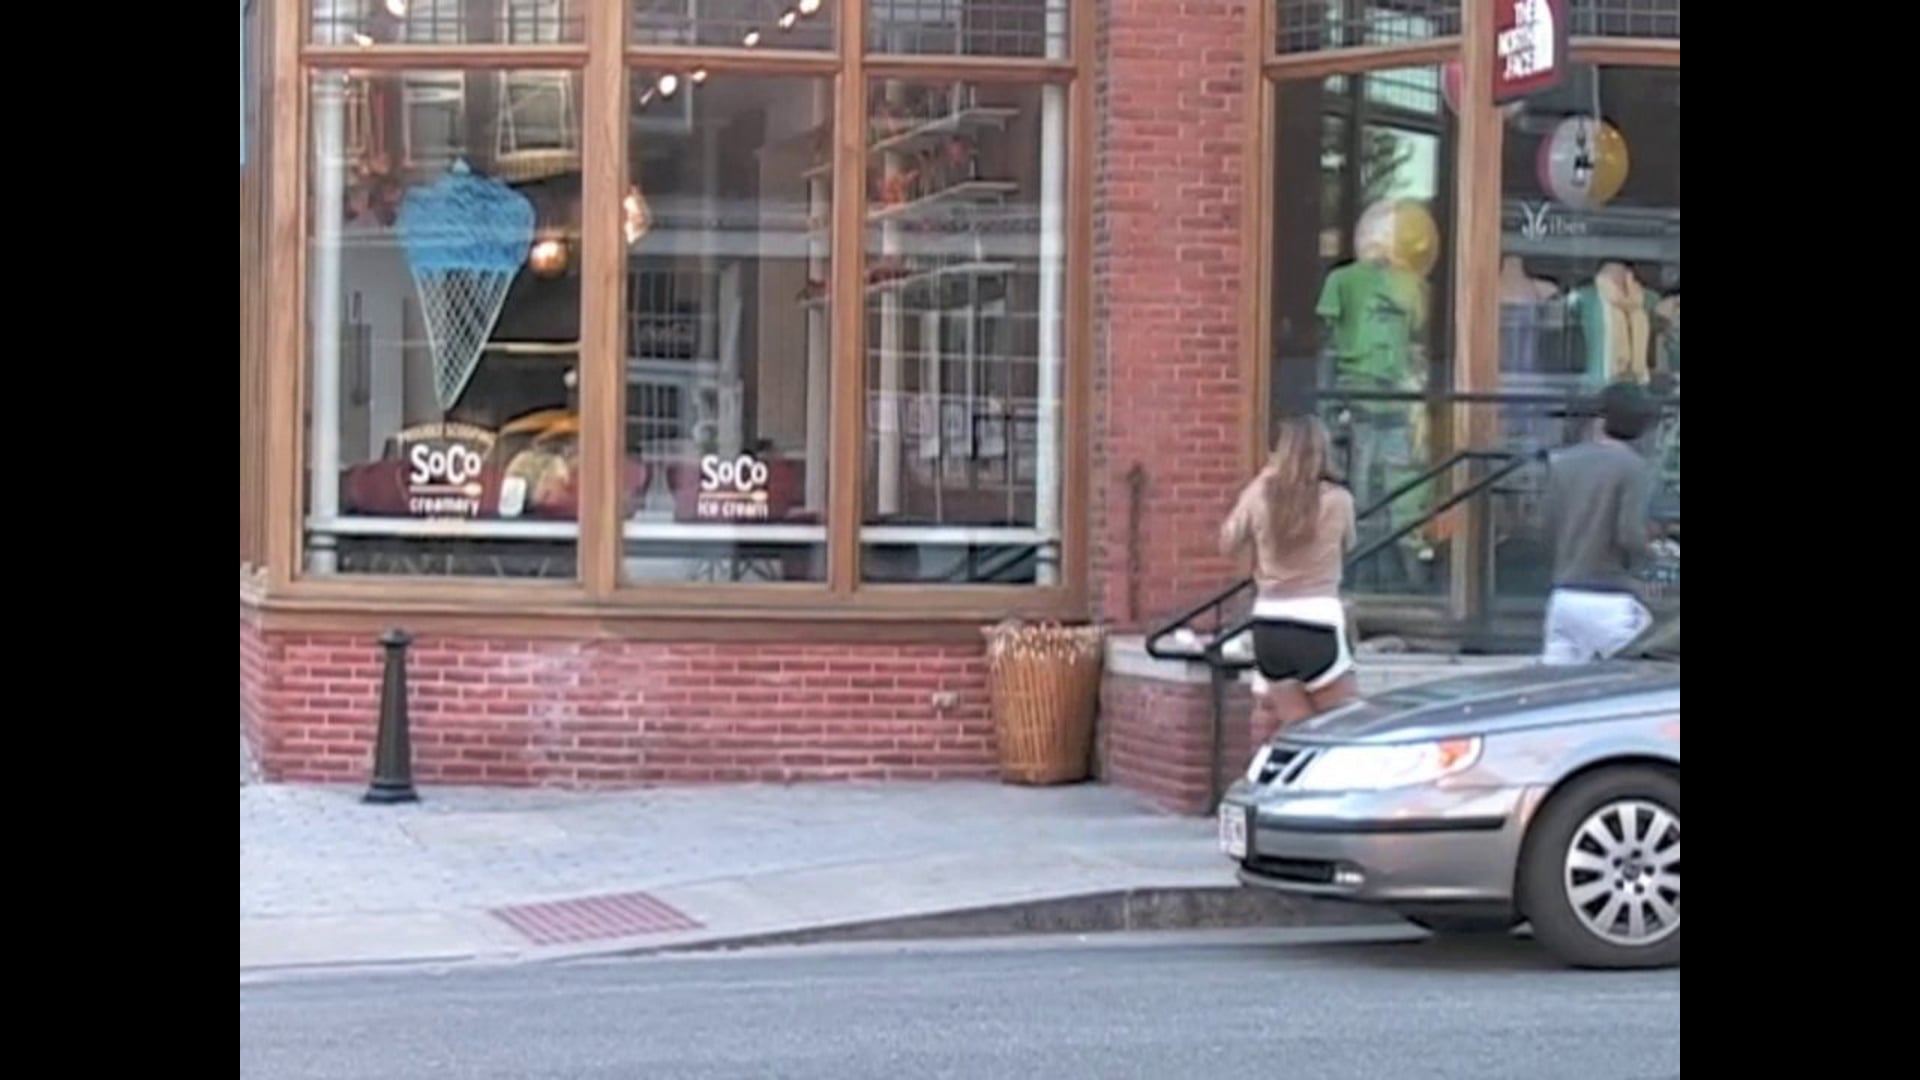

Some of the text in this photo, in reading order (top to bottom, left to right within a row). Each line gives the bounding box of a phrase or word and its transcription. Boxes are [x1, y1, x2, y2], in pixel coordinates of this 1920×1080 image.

[410, 444, 481, 484] SoCo
[701, 454, 768, 492] SoCo
[409, 497, 479, 517] creamery
[722, 501, 768, 518] cream
